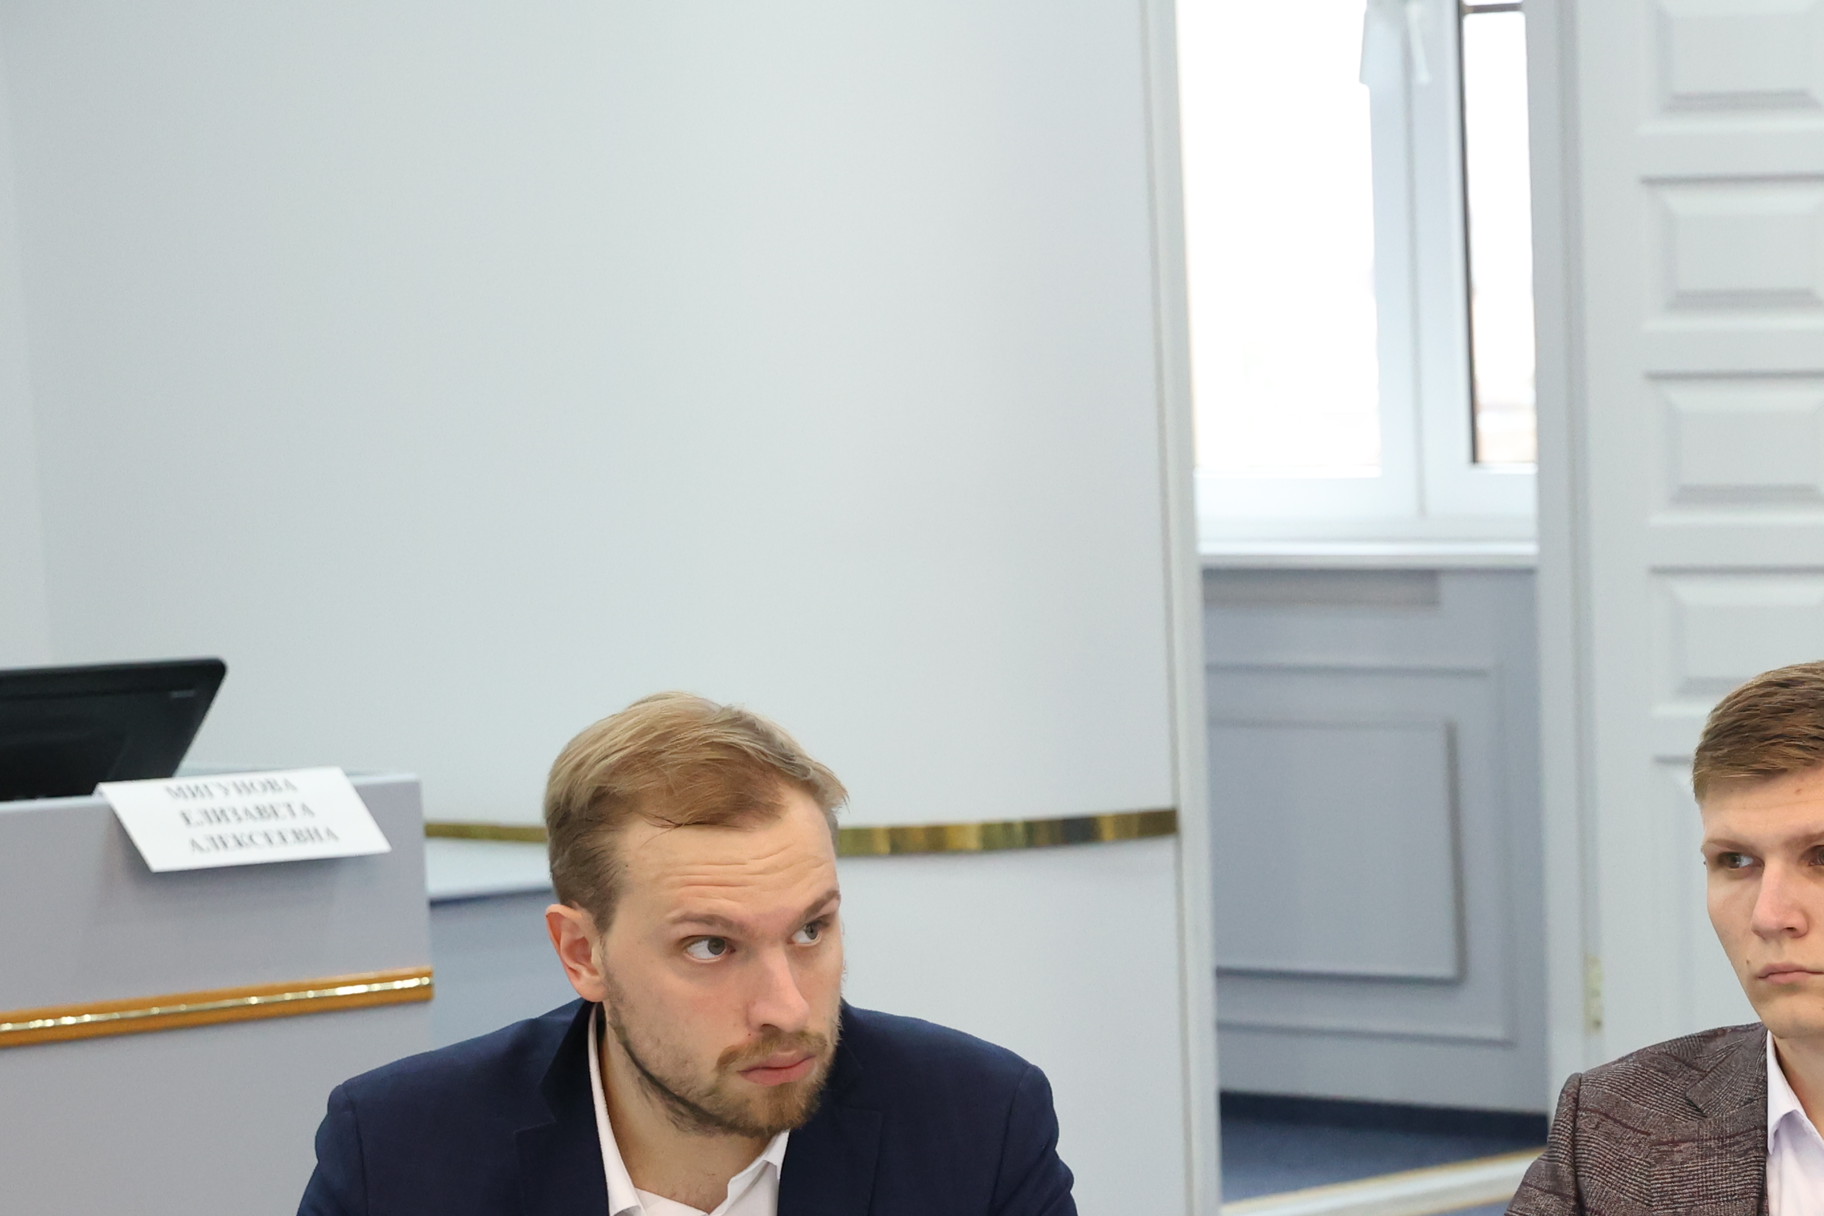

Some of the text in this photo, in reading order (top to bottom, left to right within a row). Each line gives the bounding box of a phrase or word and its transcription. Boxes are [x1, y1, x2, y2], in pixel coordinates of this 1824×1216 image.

[164, 778, 300, 802] МИГУНОВА
[179, 802, 316, 828] ЕЛИЗАВЕТА
[189, 827, 341, 854] АЛЕКСЕЕВНА
